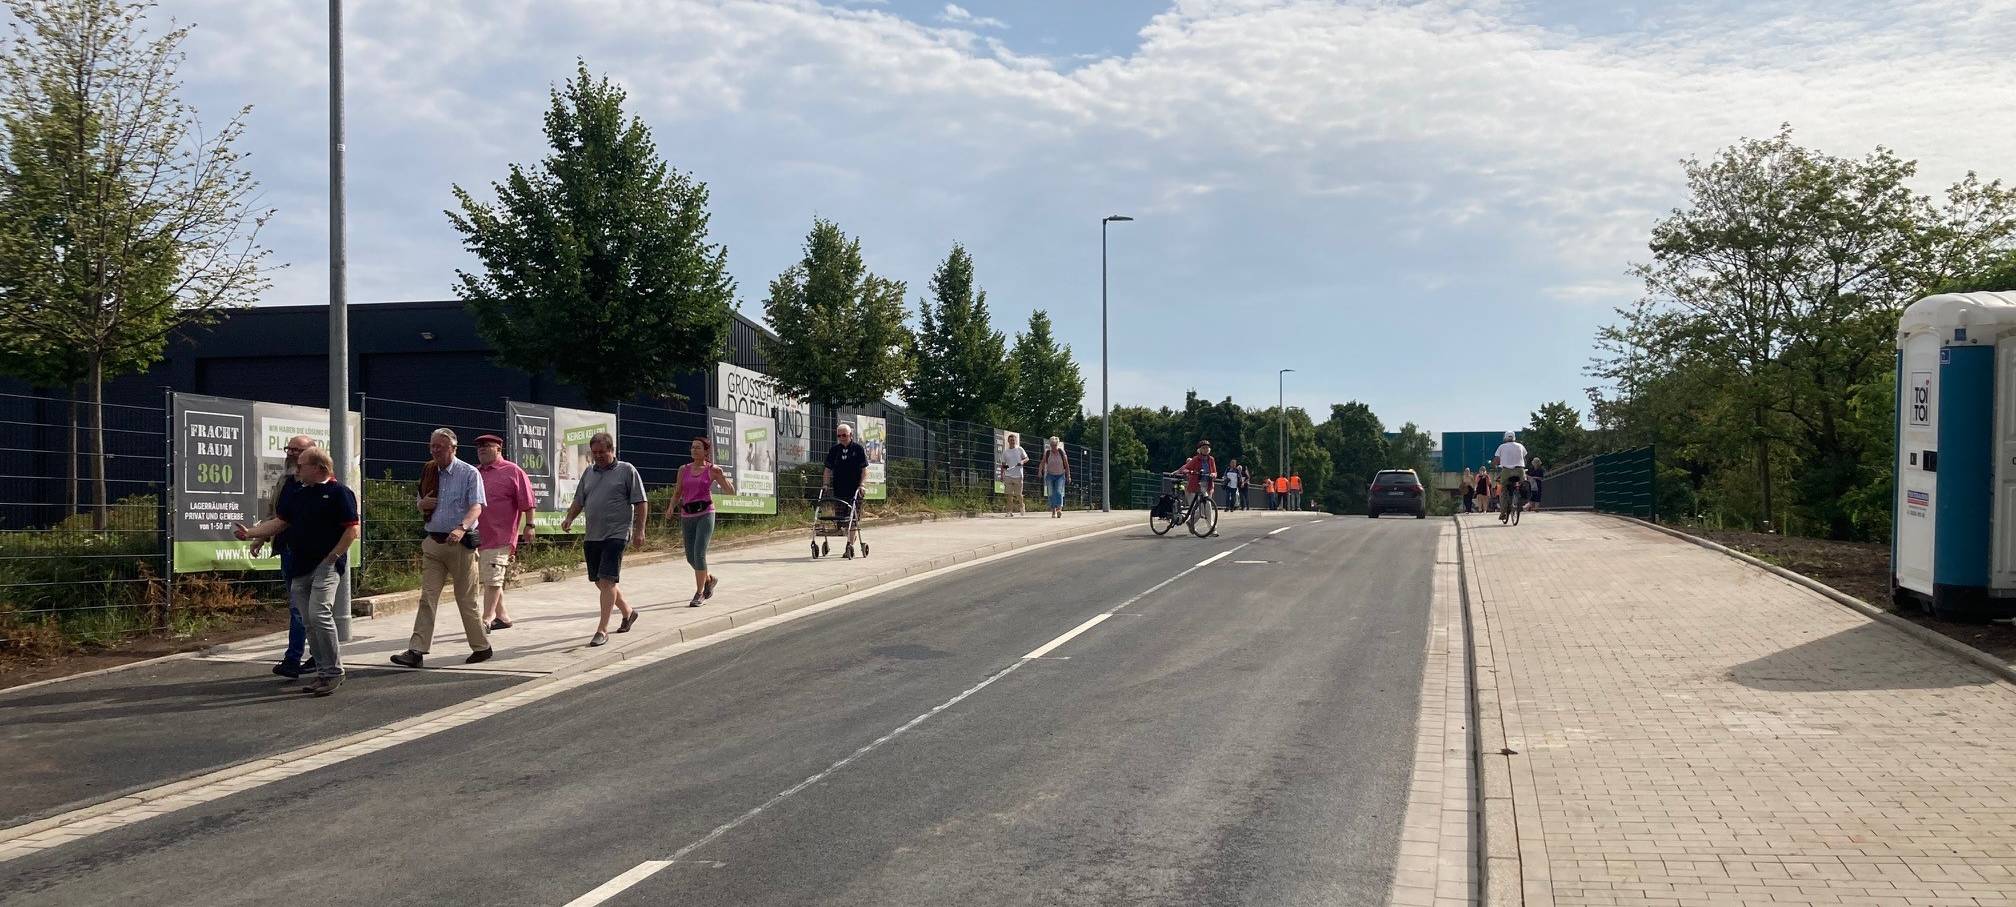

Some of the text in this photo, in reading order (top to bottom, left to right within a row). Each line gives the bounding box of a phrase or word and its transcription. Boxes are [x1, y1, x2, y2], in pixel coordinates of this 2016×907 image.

[1914, 386, 1929, 404] TOI
[1914, 404, 1928, 421] TOI
[190, 424, 239, 440] FRACHT
[518, 424, 547, 437] FRACHT
[197, 442, 233, 457] RAUM
[522, 437, 543, 449] RAUM
[522, 453, 544, 469] 360
[197, 463, 233, 484] 360
[190, 501, 240, 511] LAGERRÄUME FÜR
[184, 512, 205, 520] PRIVAT
